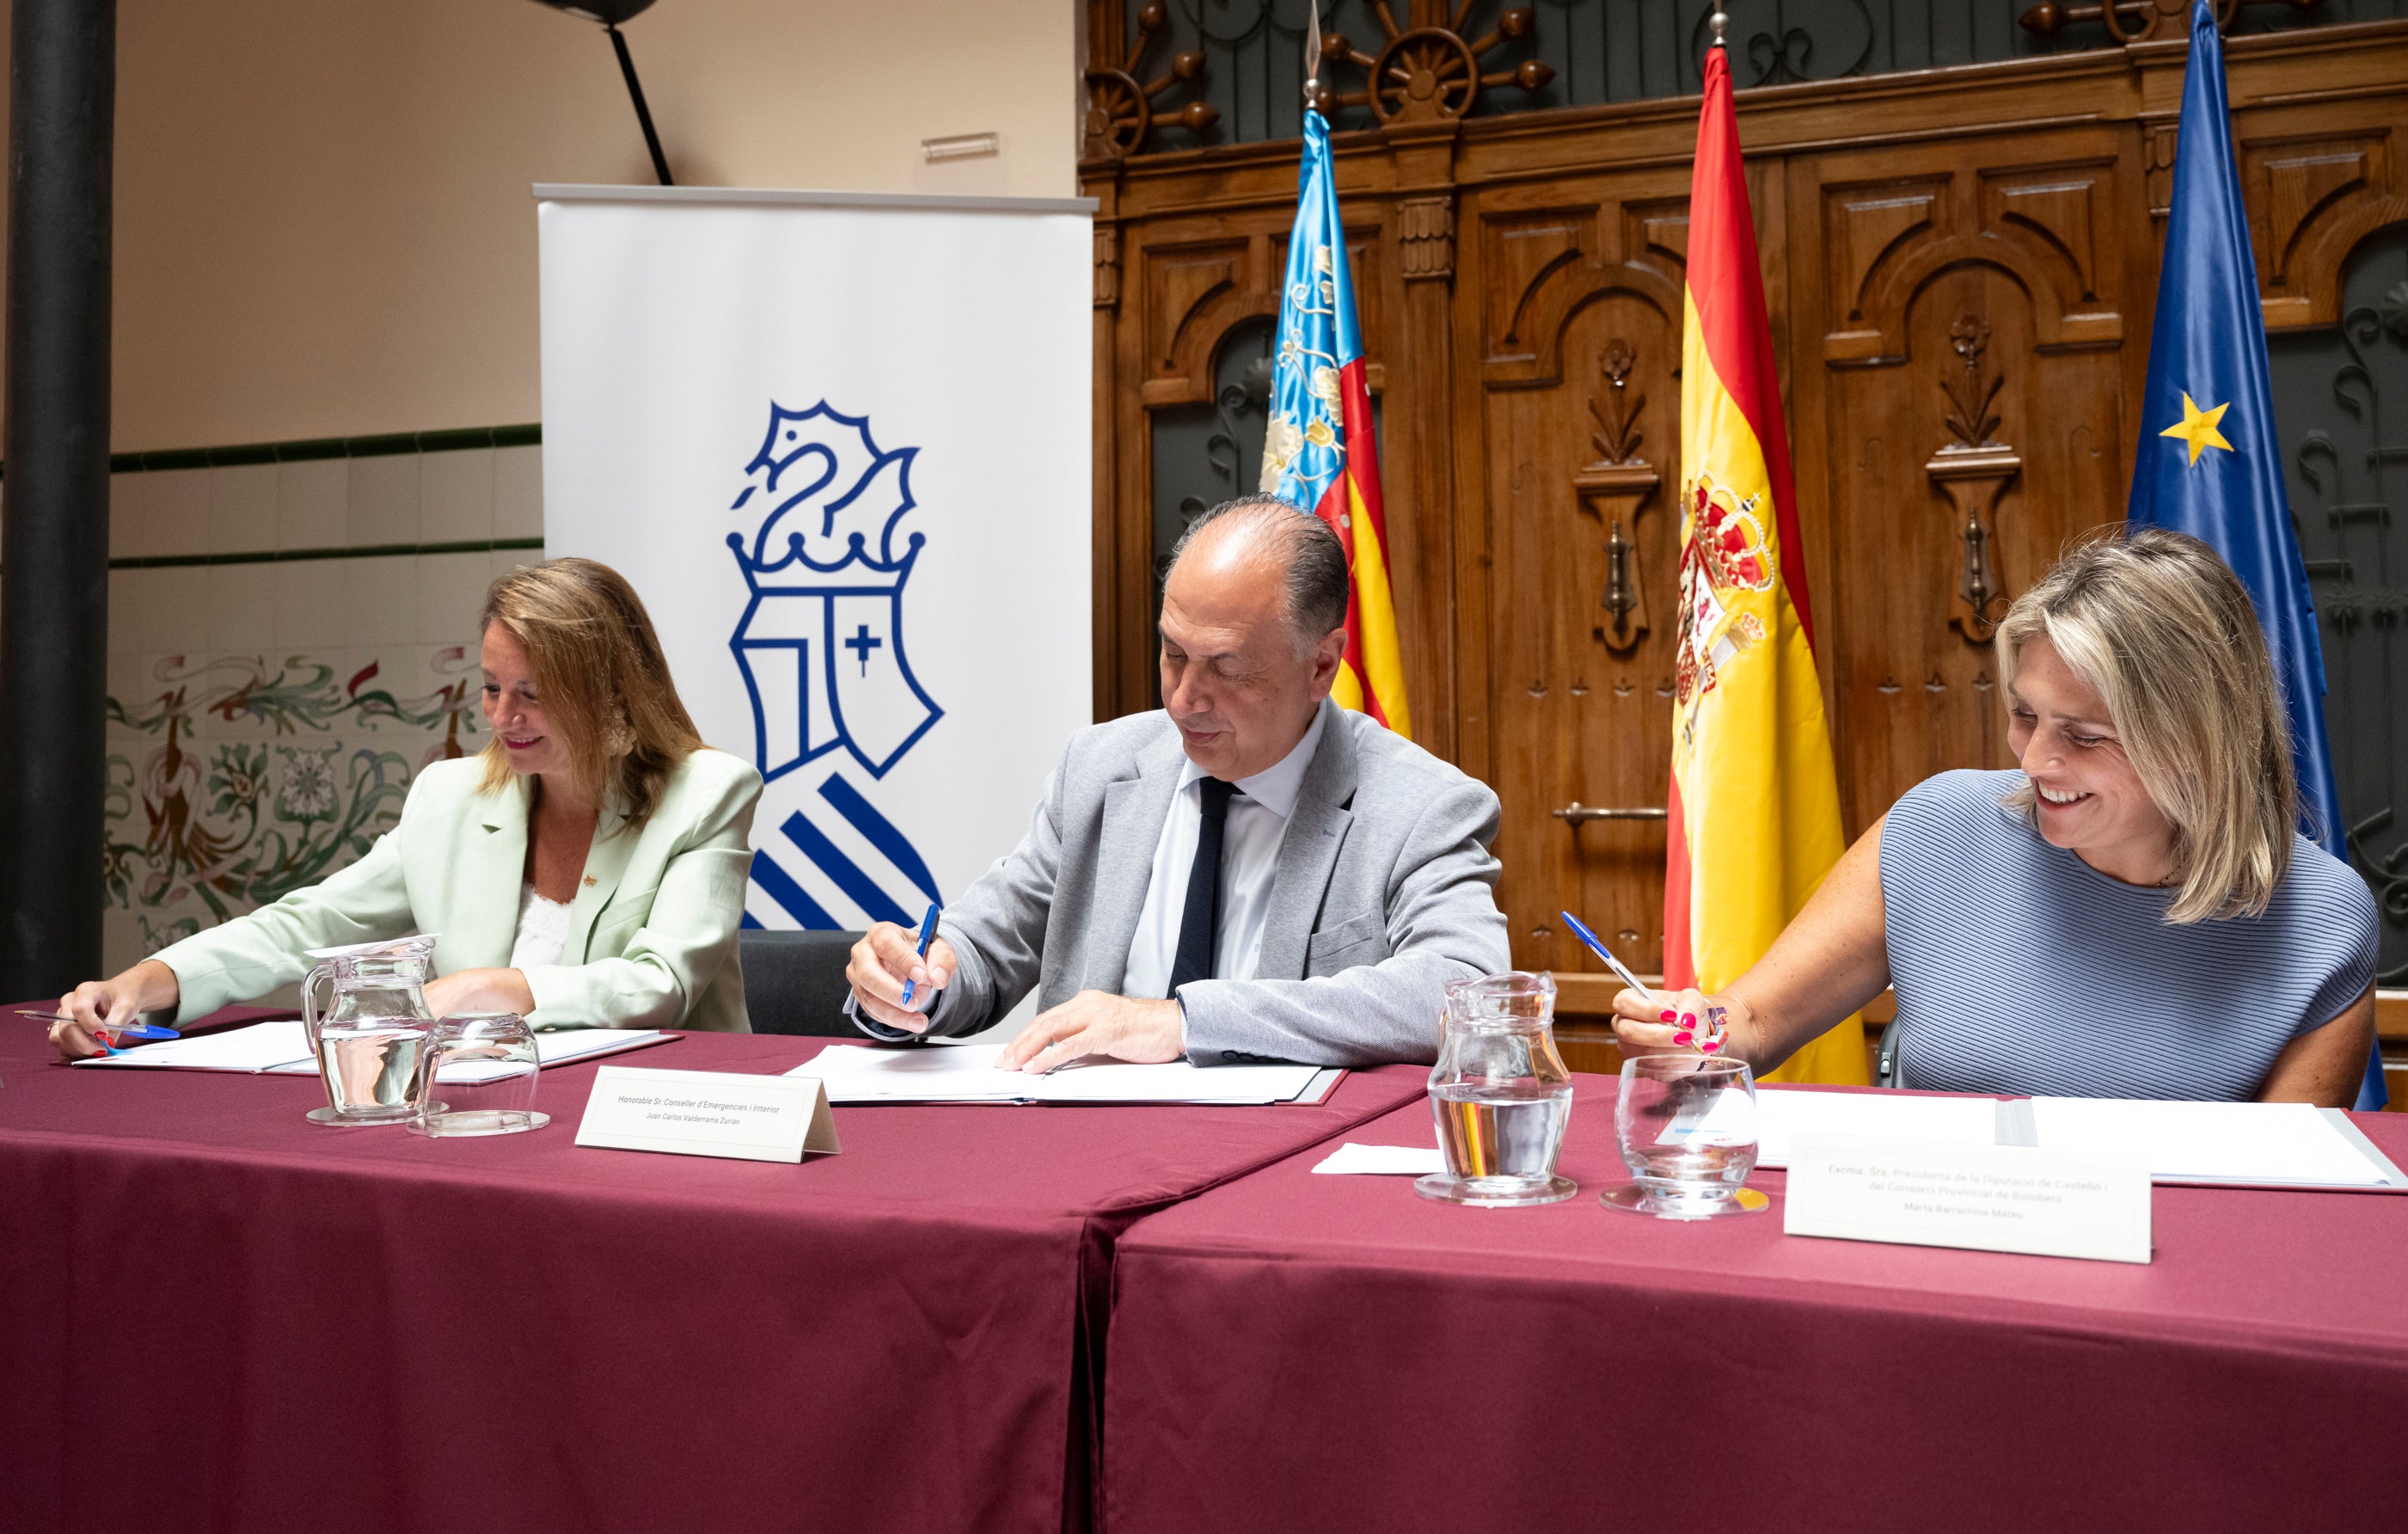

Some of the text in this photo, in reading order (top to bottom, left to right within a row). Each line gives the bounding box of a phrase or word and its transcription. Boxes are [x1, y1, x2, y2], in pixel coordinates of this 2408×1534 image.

[618, 1095, 652, 1105] Honorable
[664, 1097, 695, 1108] Conseller
[754, 1104, 780, 1113] Interior
[662, 1113, 682, 1121] Carlos
[683, 1114, 719, 1123] Valderrama
[1829, 1163, 1865, 1175] Excma.
[1893, 1168, 1951, 1181] Presidenta
[1954, 1173, 1967, 1181] de
[1970, 1174, 1979, 1183] la
[1983, 1175, 2034, 1187] Diputació
[2038, 1179, 2051, 1187] de
[1869, 1182, 1884, 1191] del
[1888, 1182, 1934, 1193] Consorci
[1939, 1185, 1992, 1198] Provincial
[2013, 1191, 2062, 1203] Bombers
[1904, 1202, 2023, 1218] Marta Barrachina Mateu
